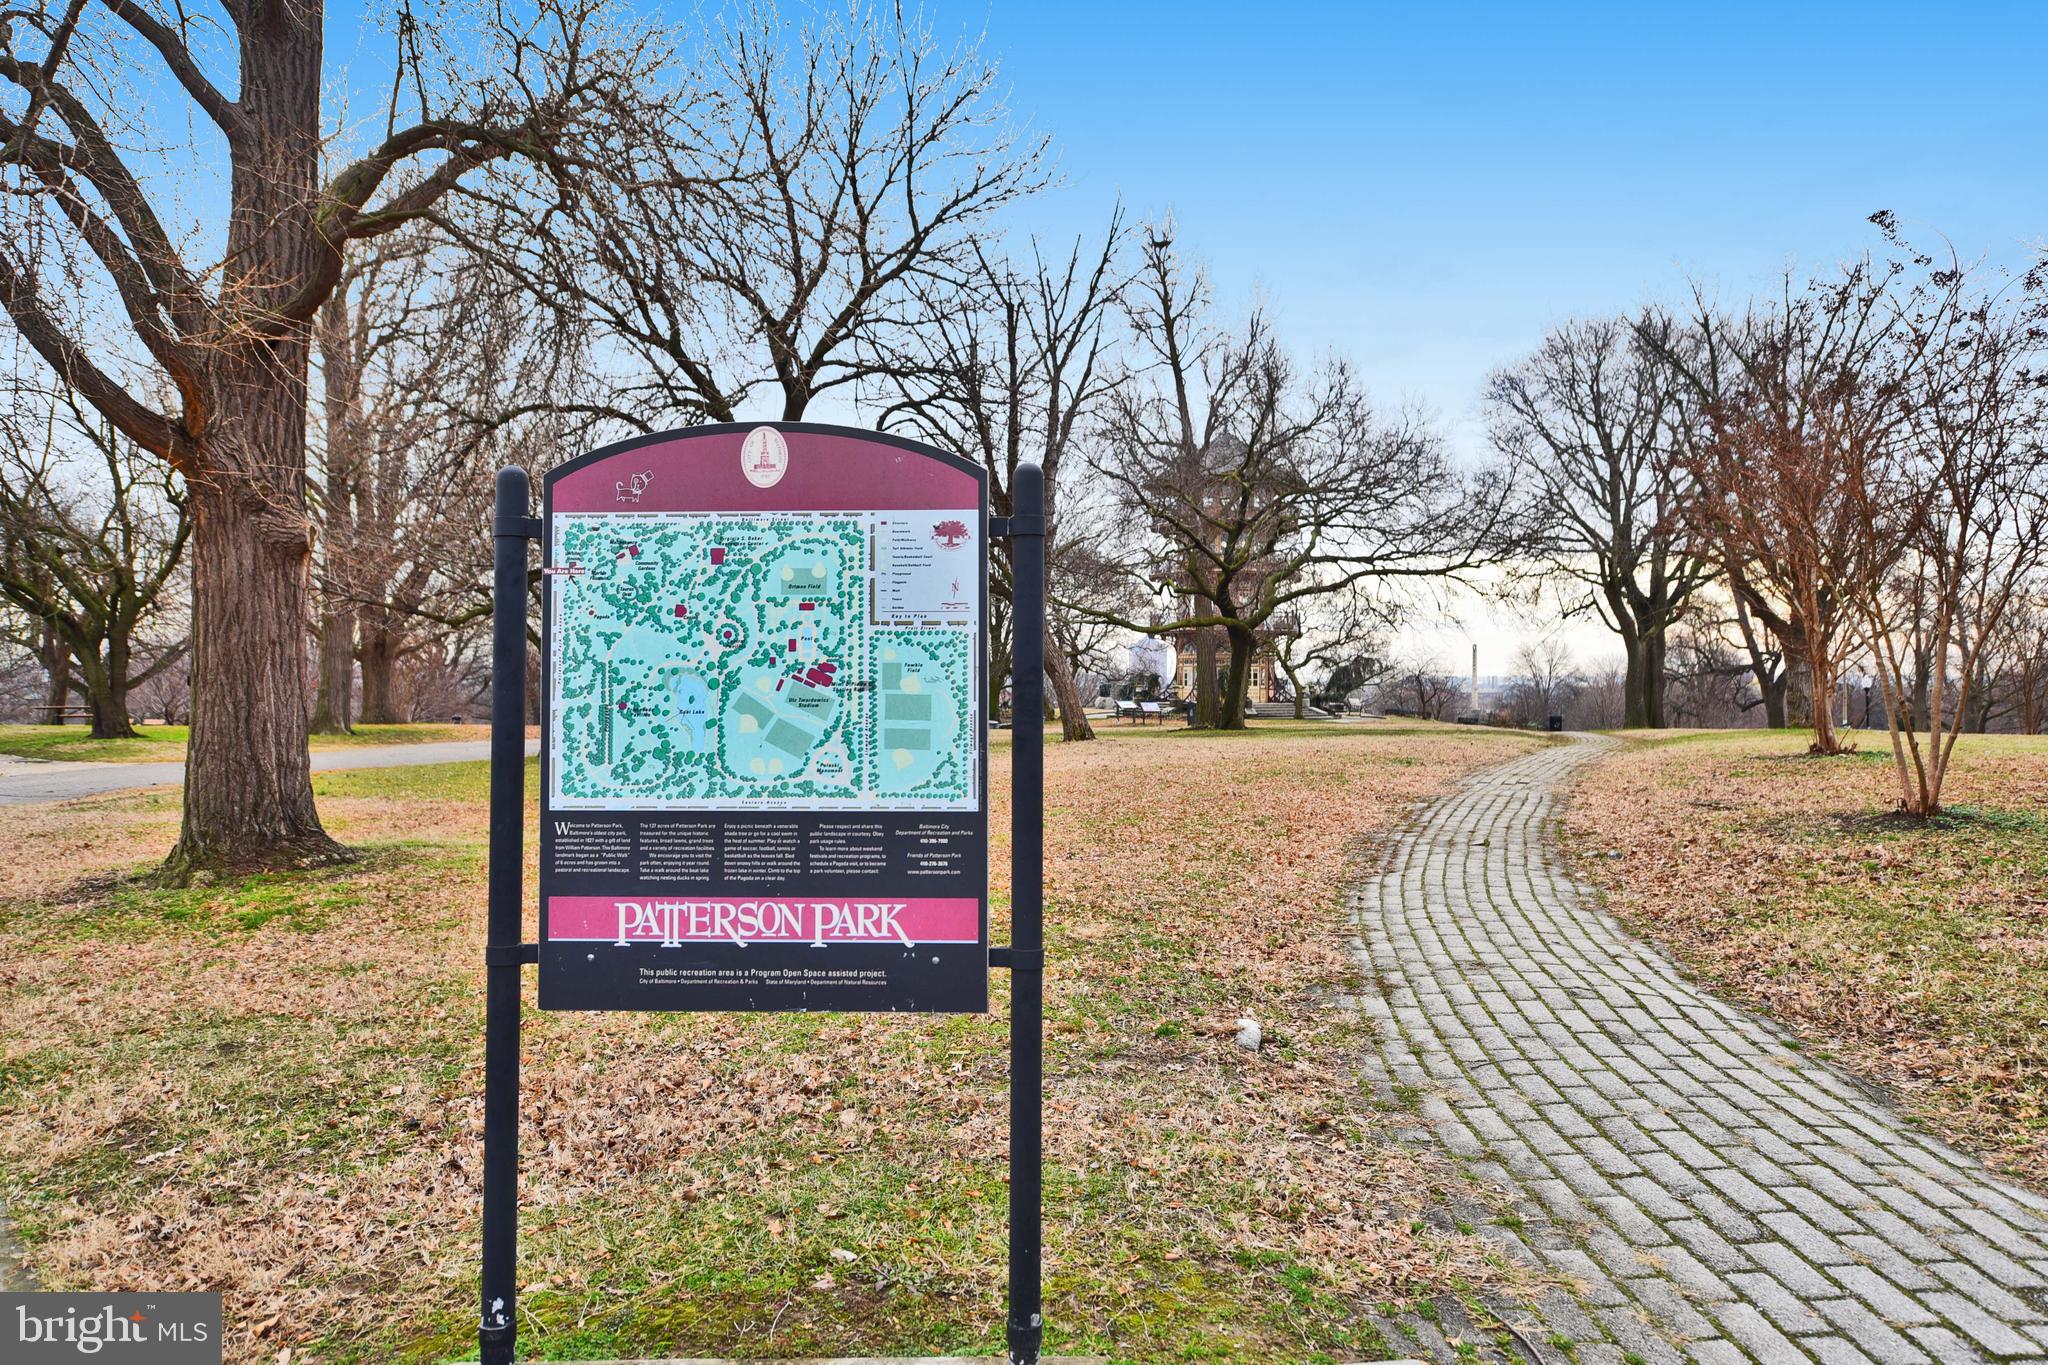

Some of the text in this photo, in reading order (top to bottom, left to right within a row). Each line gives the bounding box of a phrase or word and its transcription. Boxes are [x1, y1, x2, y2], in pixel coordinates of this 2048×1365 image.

[614, 900, 915, 948] PATTERSON PARK
[639, 968, 654, 976] This
[656, 968, 678, 978] public
[750, 968, 782, 978] Program
[782, 968, 802, 978] Open
[803, 968, 826, 978] Space
[828, 968, 858, 978] assisted
[860, 968, 887, 978] project.
